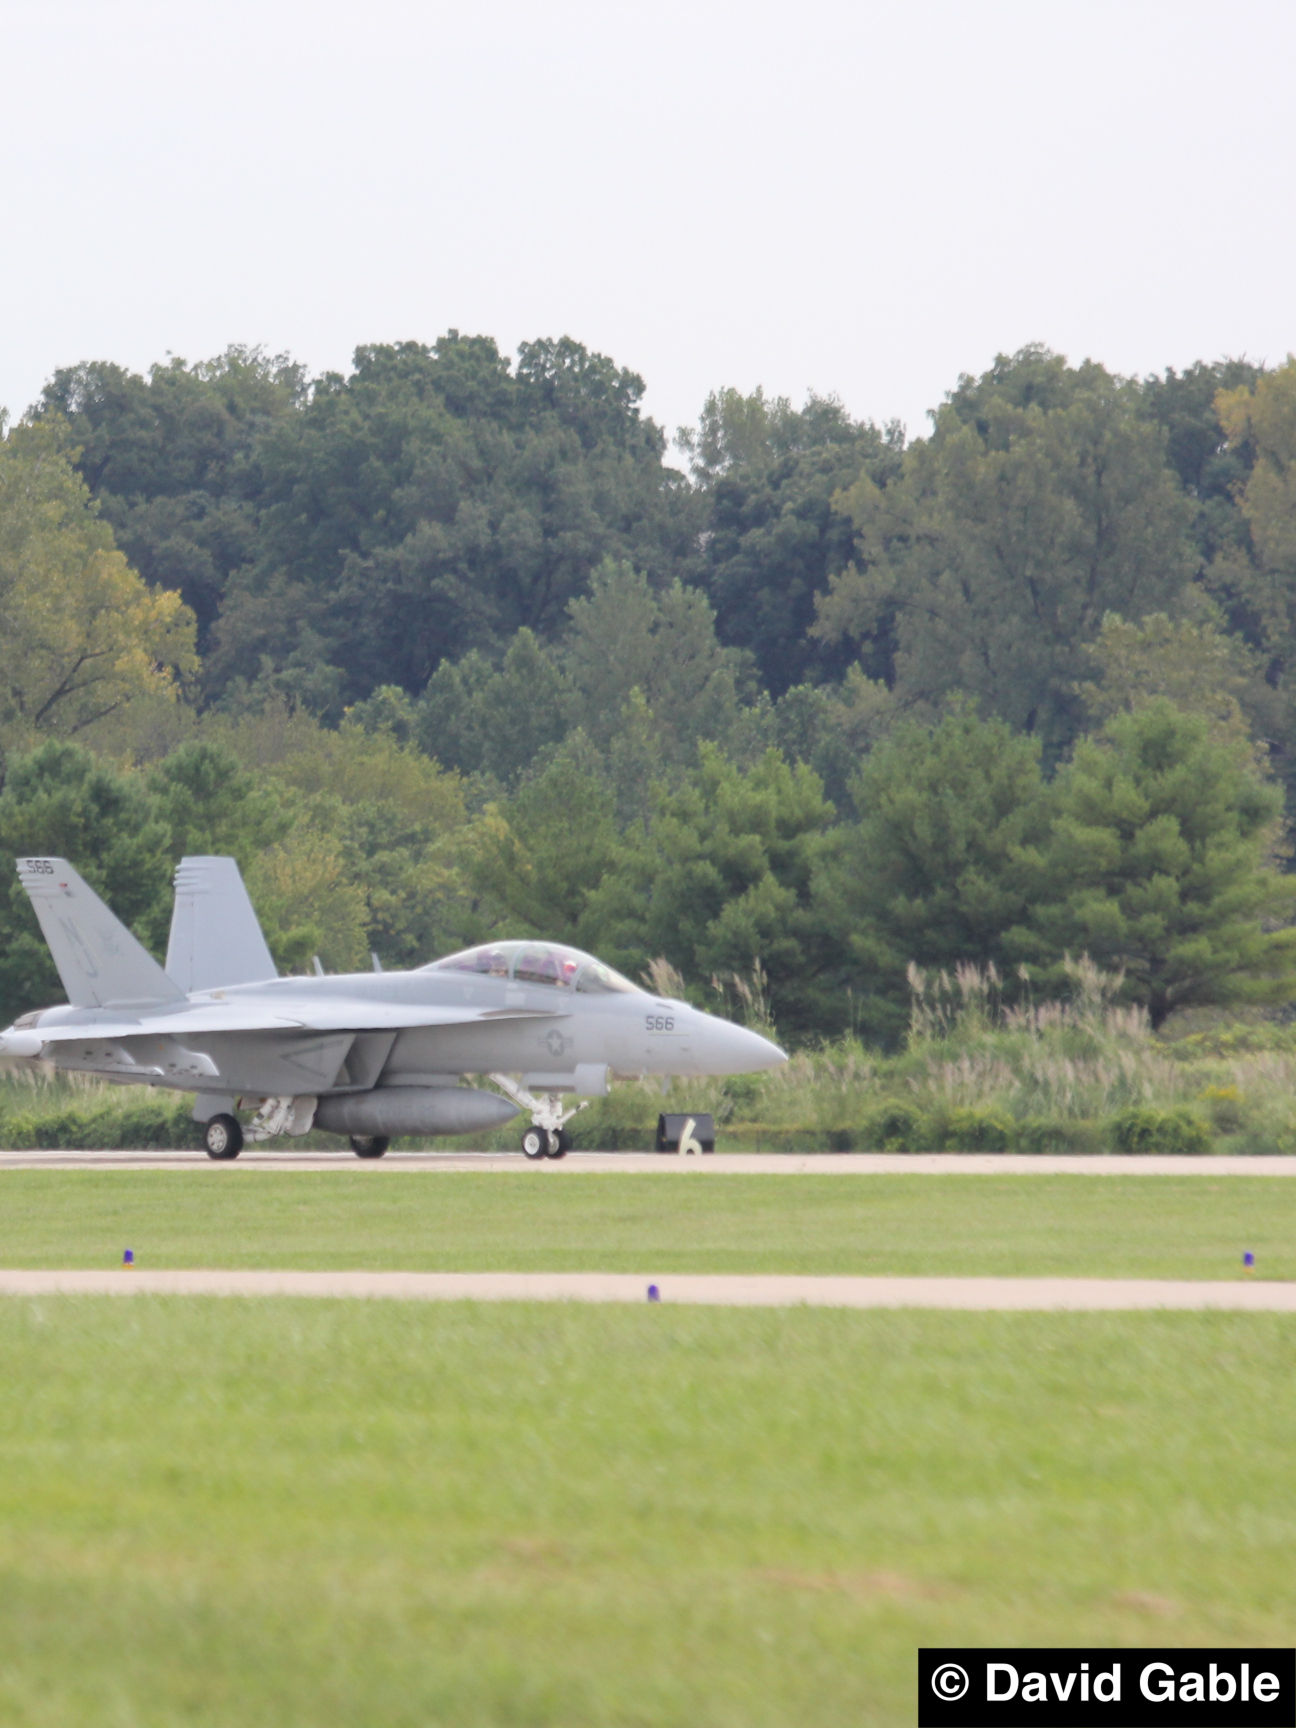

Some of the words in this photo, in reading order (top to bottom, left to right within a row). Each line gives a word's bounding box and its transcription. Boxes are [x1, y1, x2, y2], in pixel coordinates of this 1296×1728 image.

[26, 860, 54, 874] 566
[645, 1015, 674, 1031] 566
[679, 1118, 703, 1156] 6
